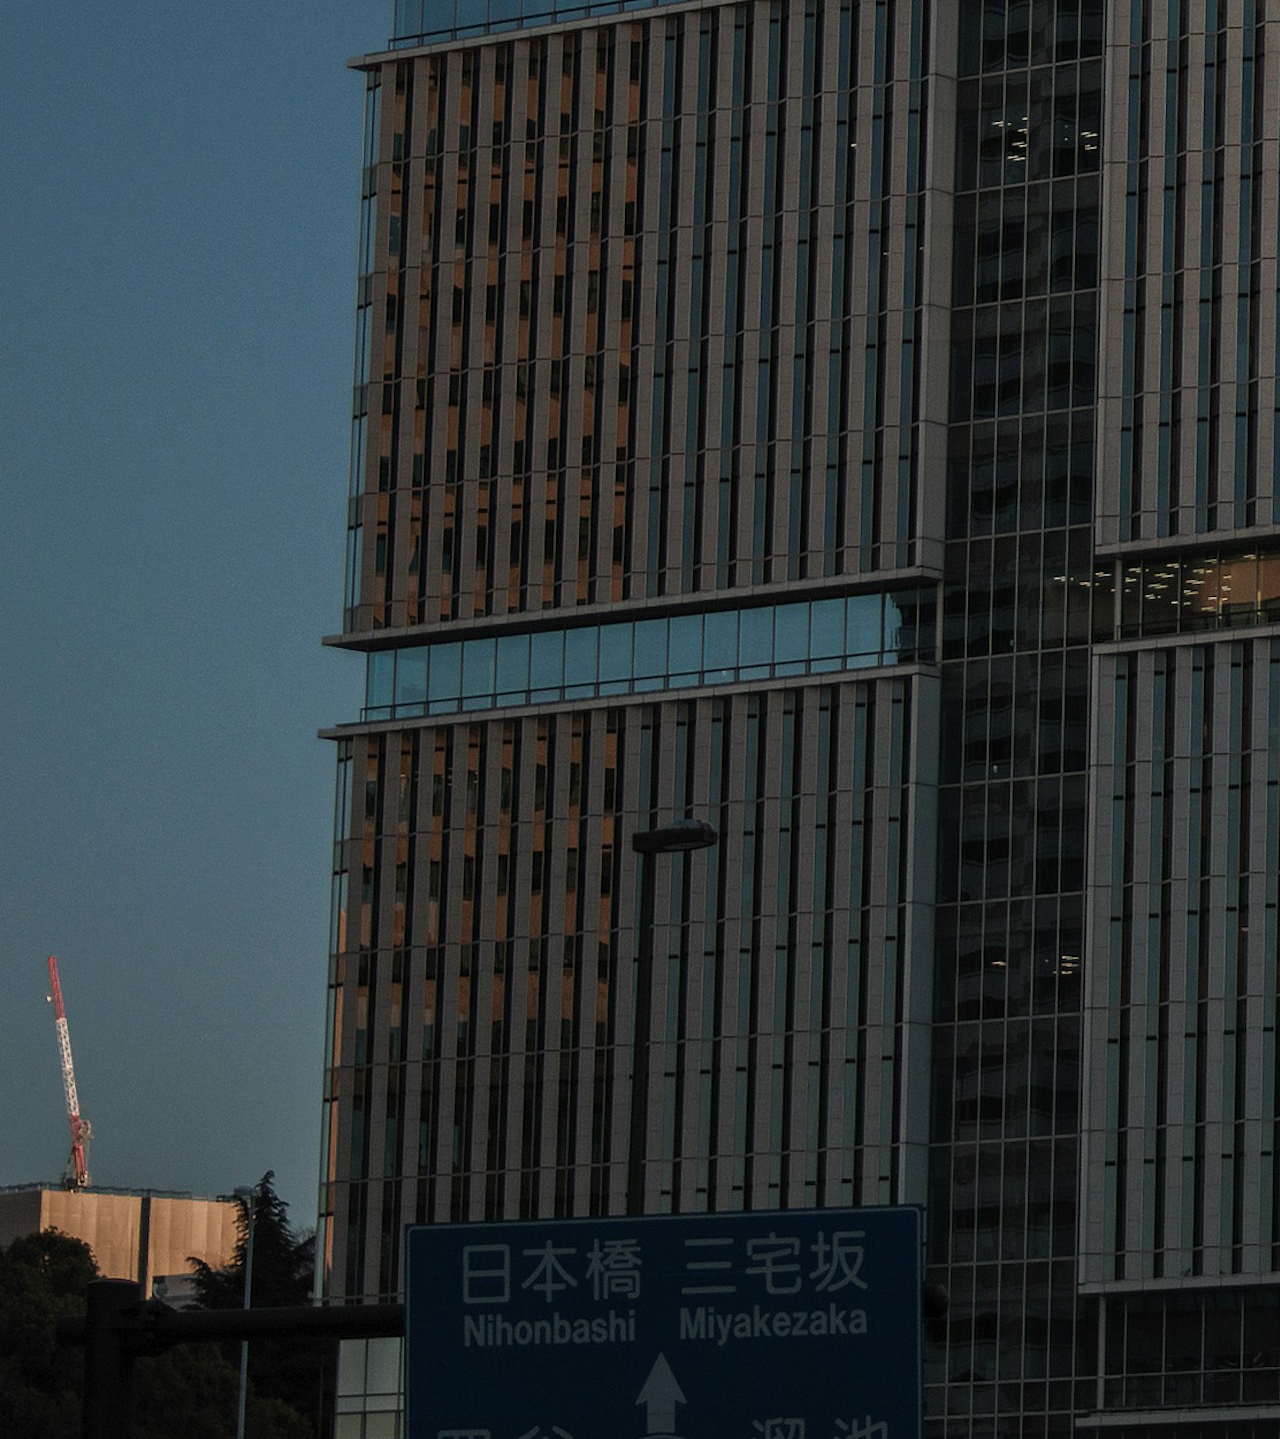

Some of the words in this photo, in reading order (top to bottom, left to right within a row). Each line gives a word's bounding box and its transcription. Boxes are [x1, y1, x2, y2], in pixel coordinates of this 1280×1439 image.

[463, 1237, 643, 1304] 日本橋
[680, 1230, 869, 1295] 三宅坂
[463, 1309, 636, 1347] Nihonbashi
[679, 1303, 868, 1346] Miyakezaka
